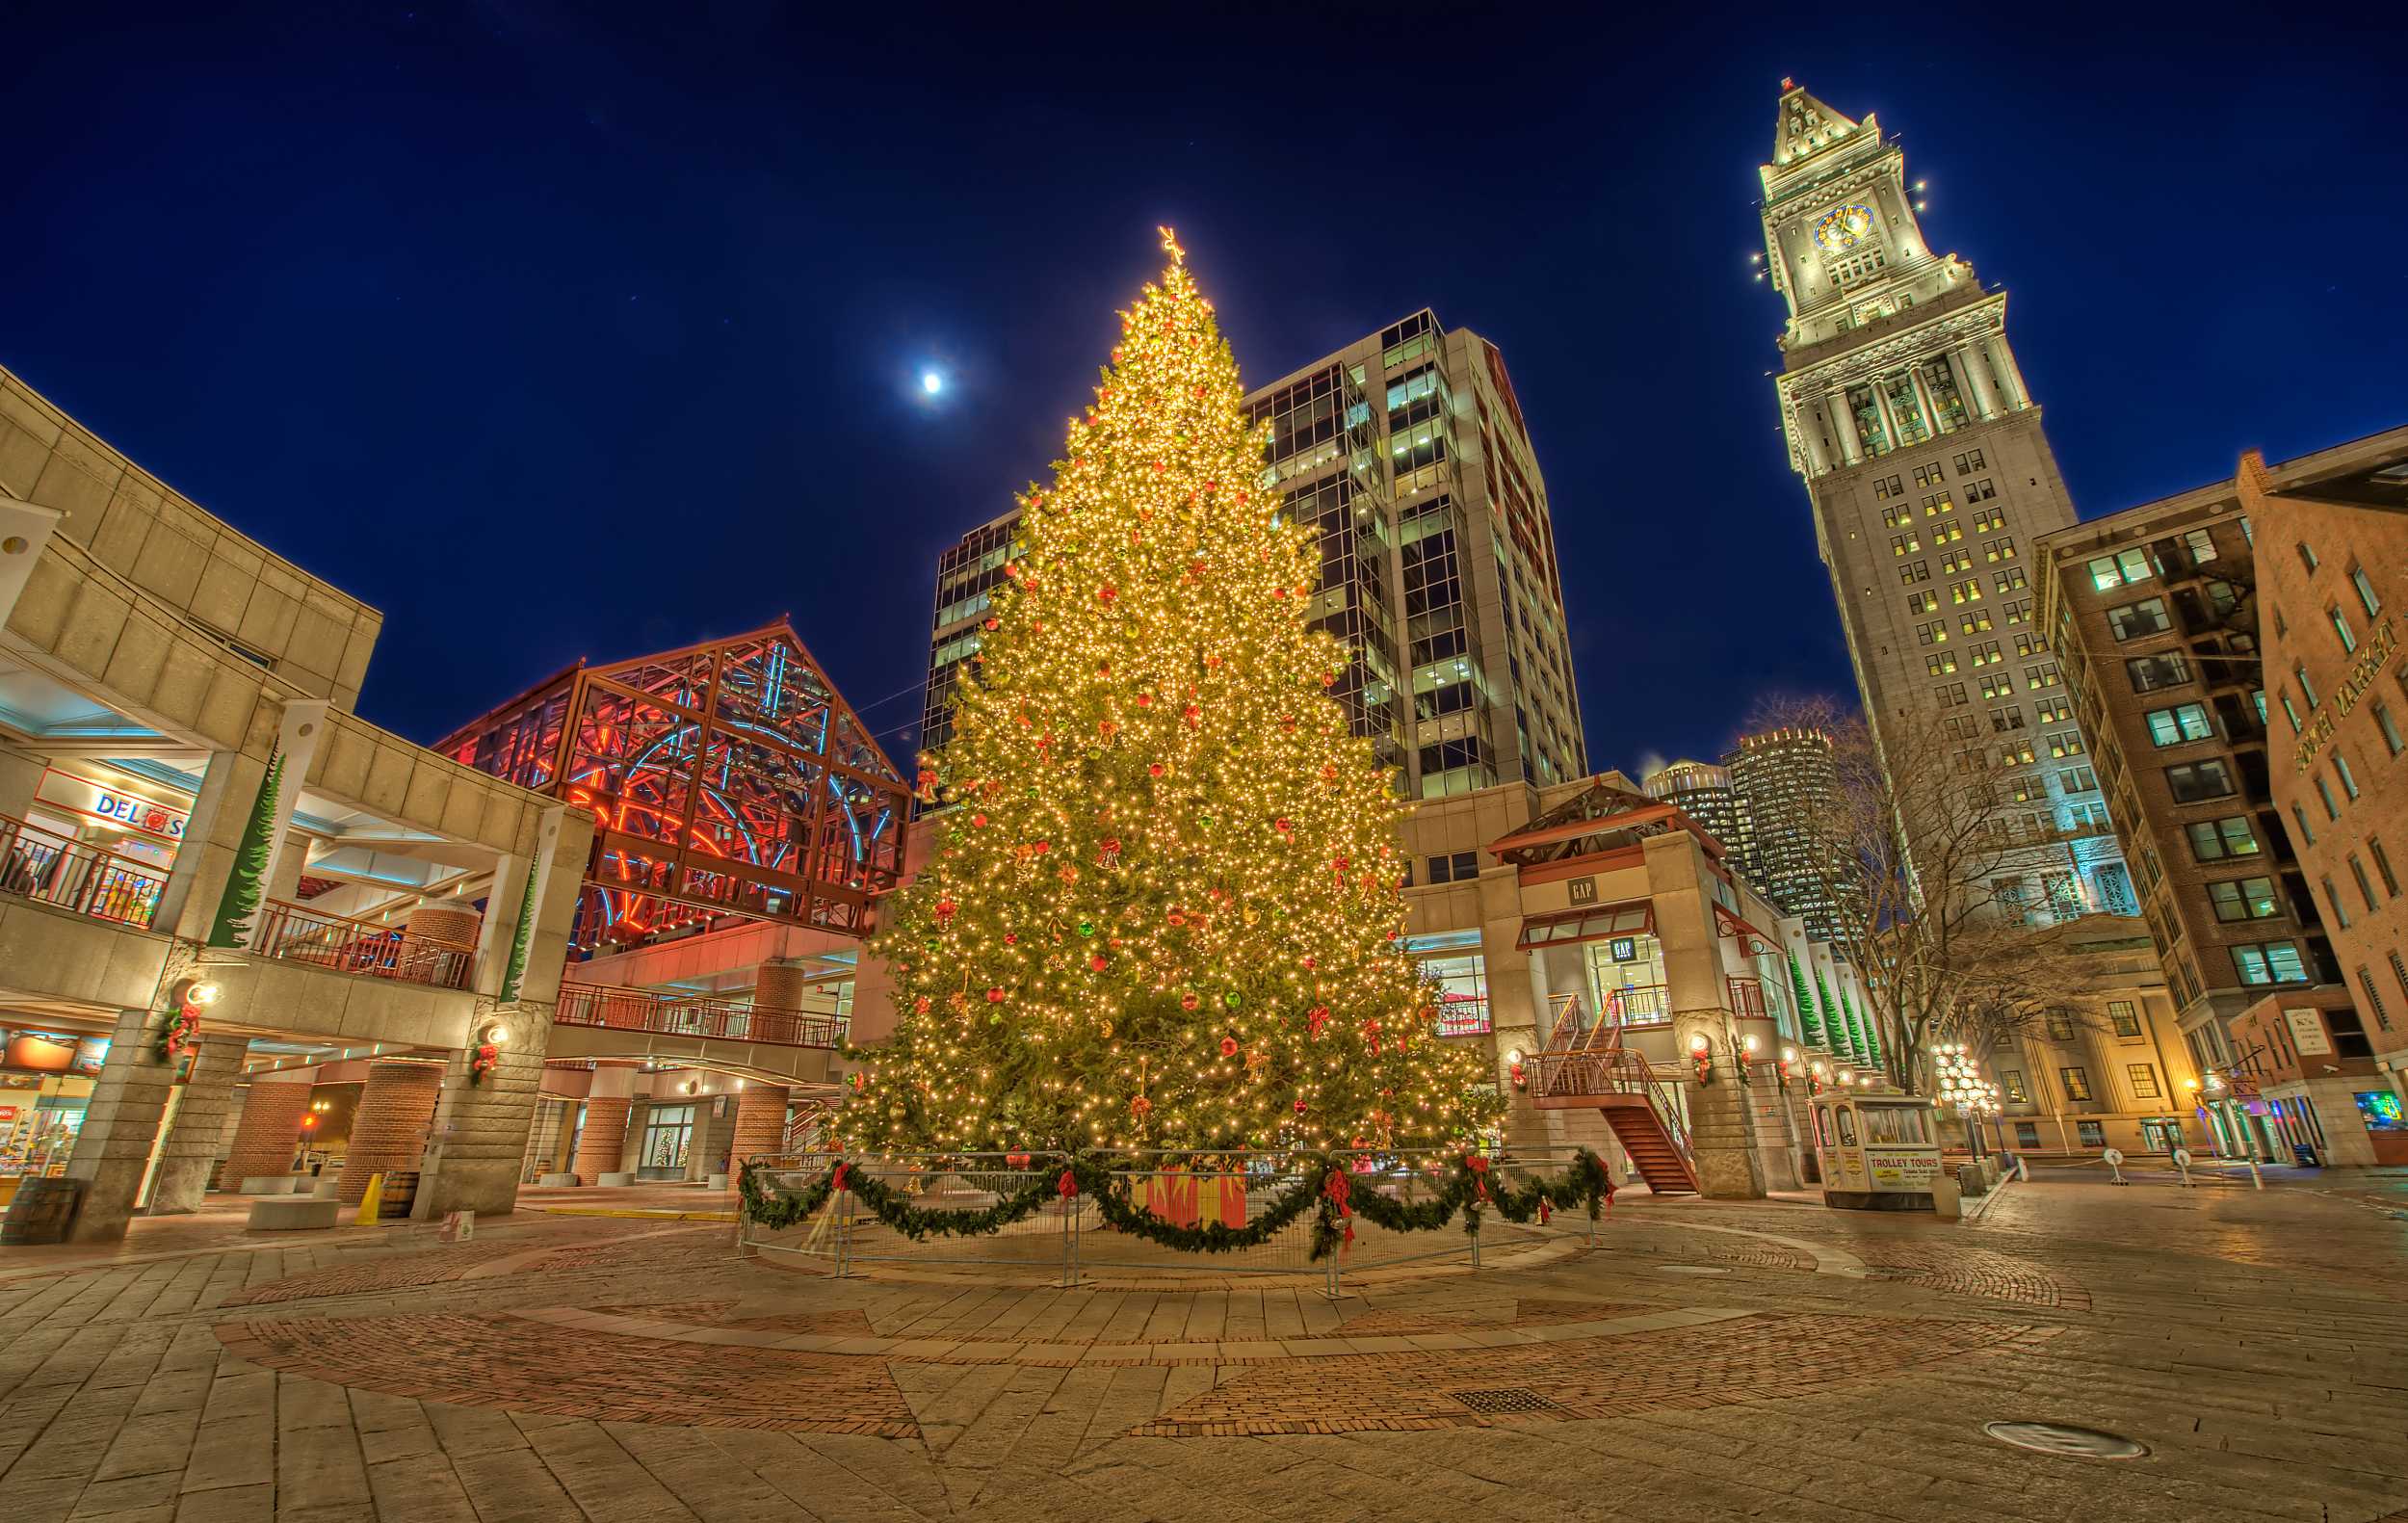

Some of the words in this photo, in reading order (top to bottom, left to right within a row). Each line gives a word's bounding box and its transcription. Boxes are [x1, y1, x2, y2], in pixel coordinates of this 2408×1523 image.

[96, 794, 140, 824] DEL
[170, 819, 187, 835] S
[1573, 882, 1591, 900] GAP
[1614, 942, 1631, 956] GAP
[1871, 1159, 1907, 1168] TROLLEY
[1910, 1159, 1938, 1168] TOURS
